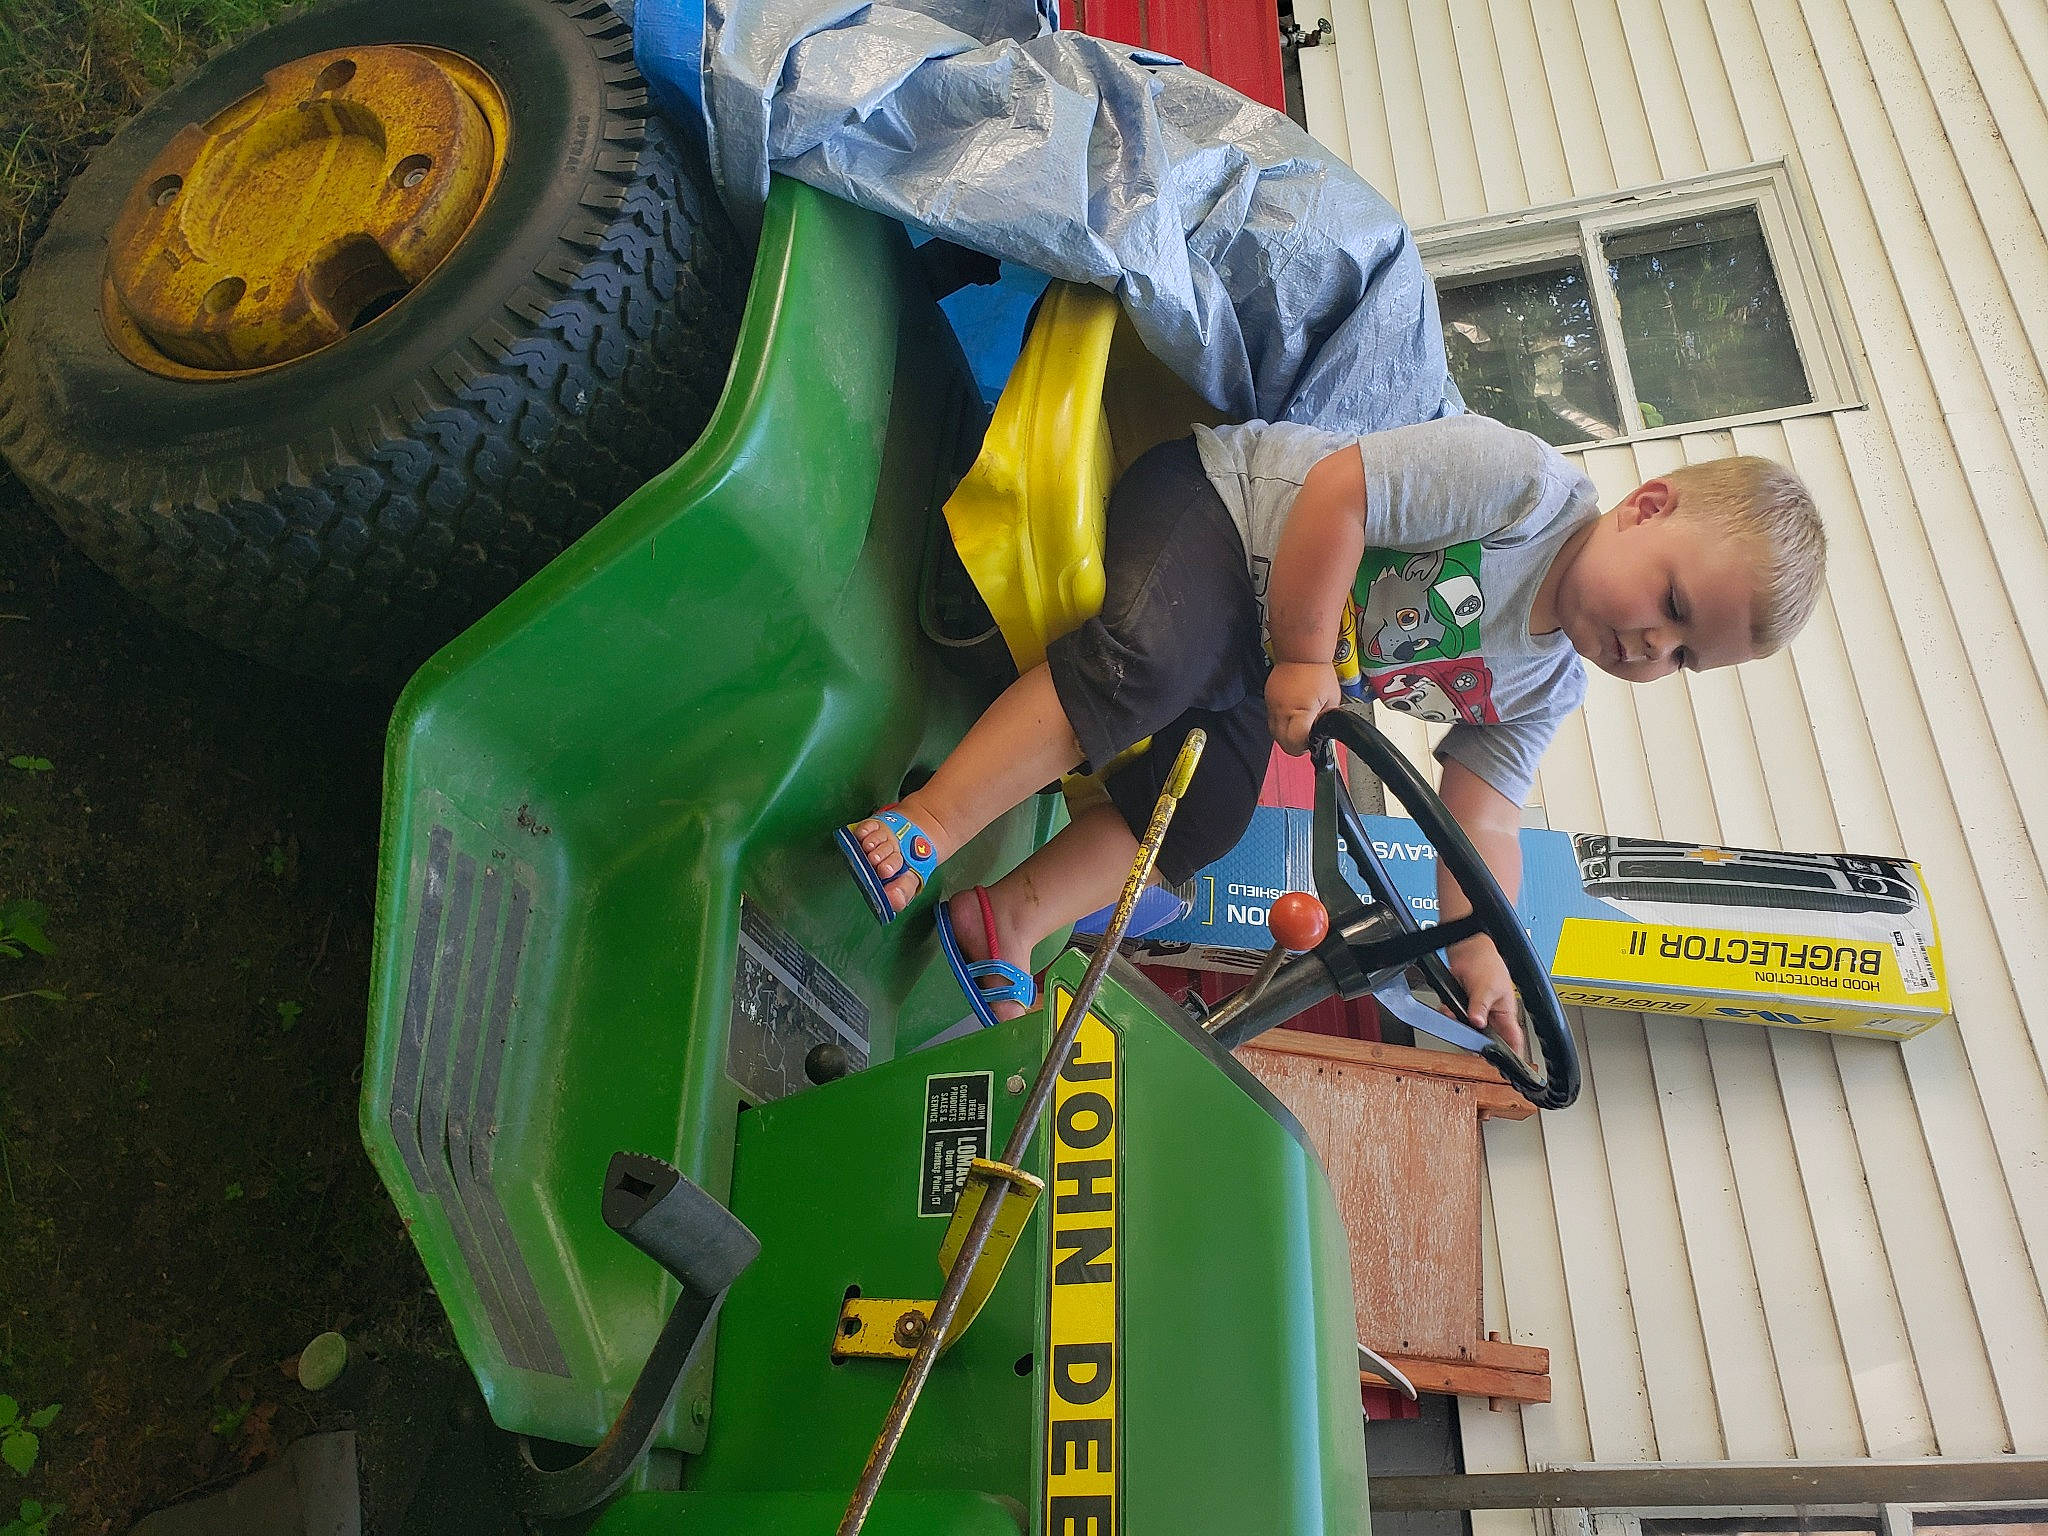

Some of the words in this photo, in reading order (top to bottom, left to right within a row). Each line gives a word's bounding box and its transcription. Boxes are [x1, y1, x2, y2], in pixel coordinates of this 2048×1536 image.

[1660, 933, 1882, 975] BUGFLECTOR
[1754, 971, 1838, 988] PROTECTION
[1842, 977, 1880, 992] HOOD
[930, 1095, 939, 1123] SERVICE
[940, 1093, 948, 1113] SALES
[949, 1086, 958, 1122] PRODUCTS
[958, 1085, 967, 1121] CONSUMER
[967, 1099, 976, 1121] DEERE
[977, 1103, 986, 1120] JOHN
[945, 1150, 954, 1167] Depot
[1055, 1042, 1114, 1286] JOHN
[931, 1197, 940, 1205] CT
